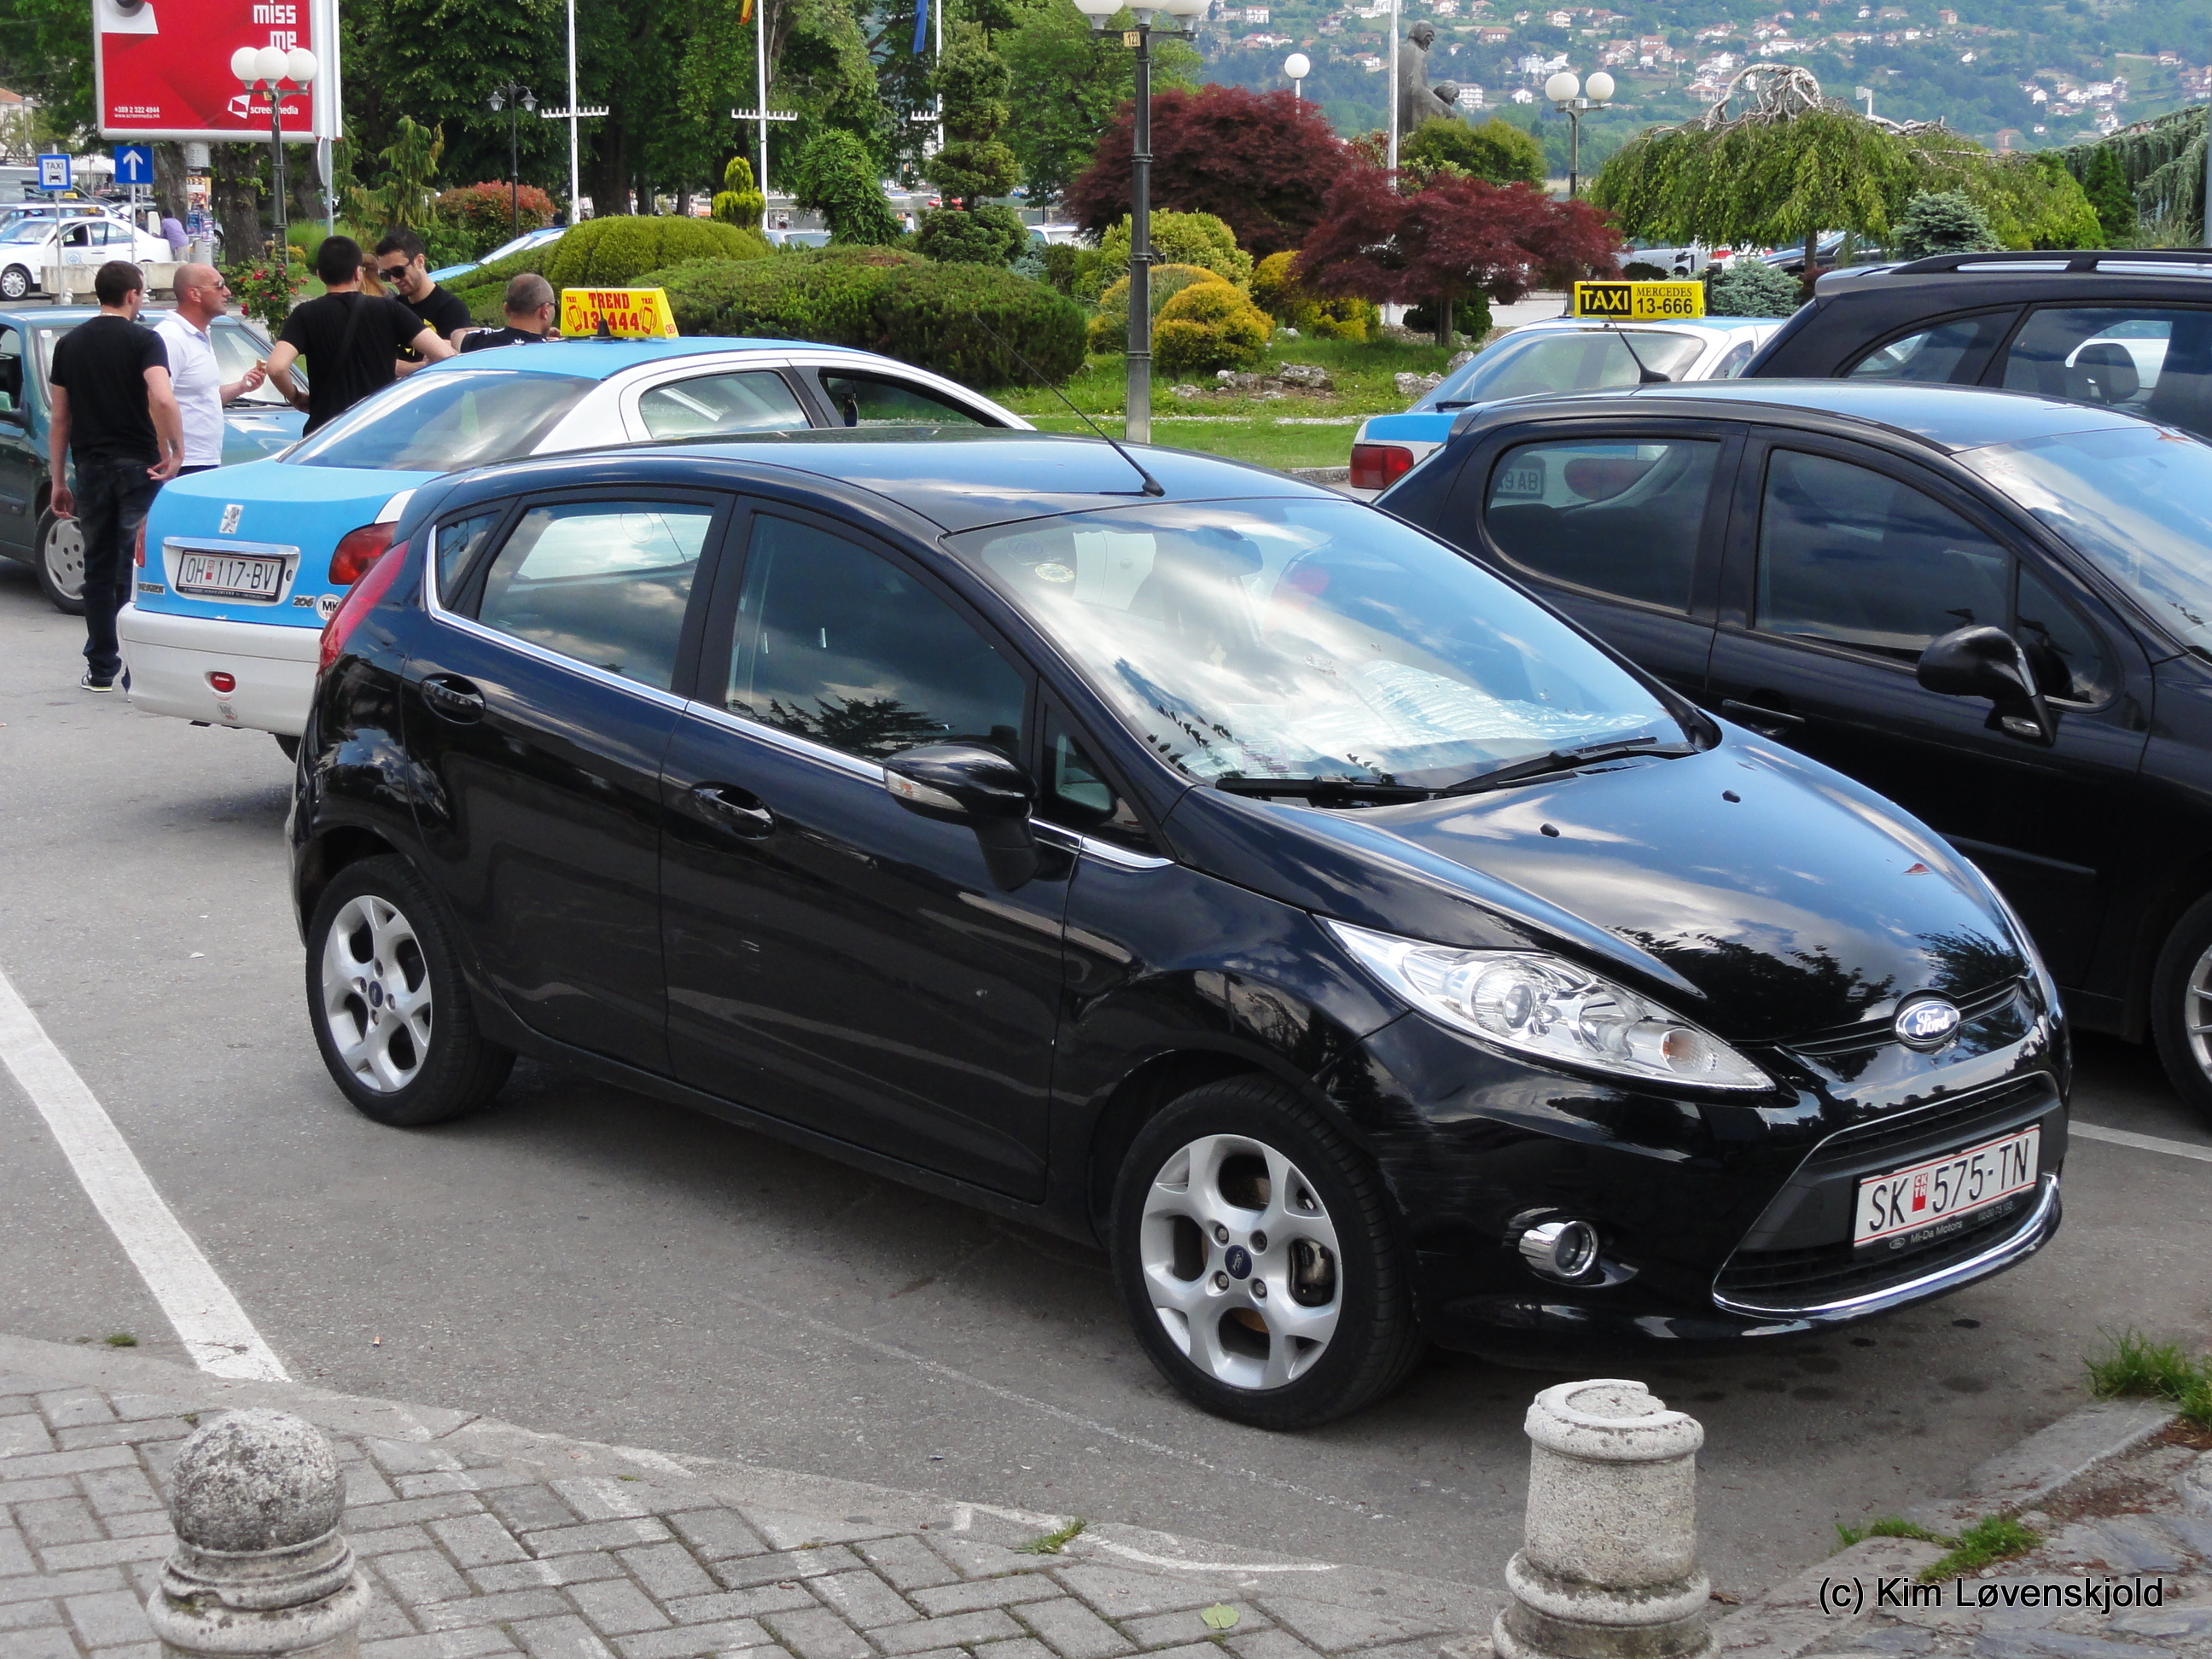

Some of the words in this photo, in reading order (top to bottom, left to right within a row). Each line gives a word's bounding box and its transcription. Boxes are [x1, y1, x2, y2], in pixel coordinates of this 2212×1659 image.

[253, 0, 297, 24] miss
[270, 31, 297, 50] me
[1580, 289, 1629, 311] TAXI
[1635, 287, 1693, 297] MERCEDES
[588, 293, 631, 310] TREND
[1636, 298, 1694, 314] 13-666
[293, 596, 315, 608] 206
[1916, 1008, 1950, 1036] Ford
[1869, 1177, 1909, 1231] SK
[1936, 1220, 1963, 1235] Motors
